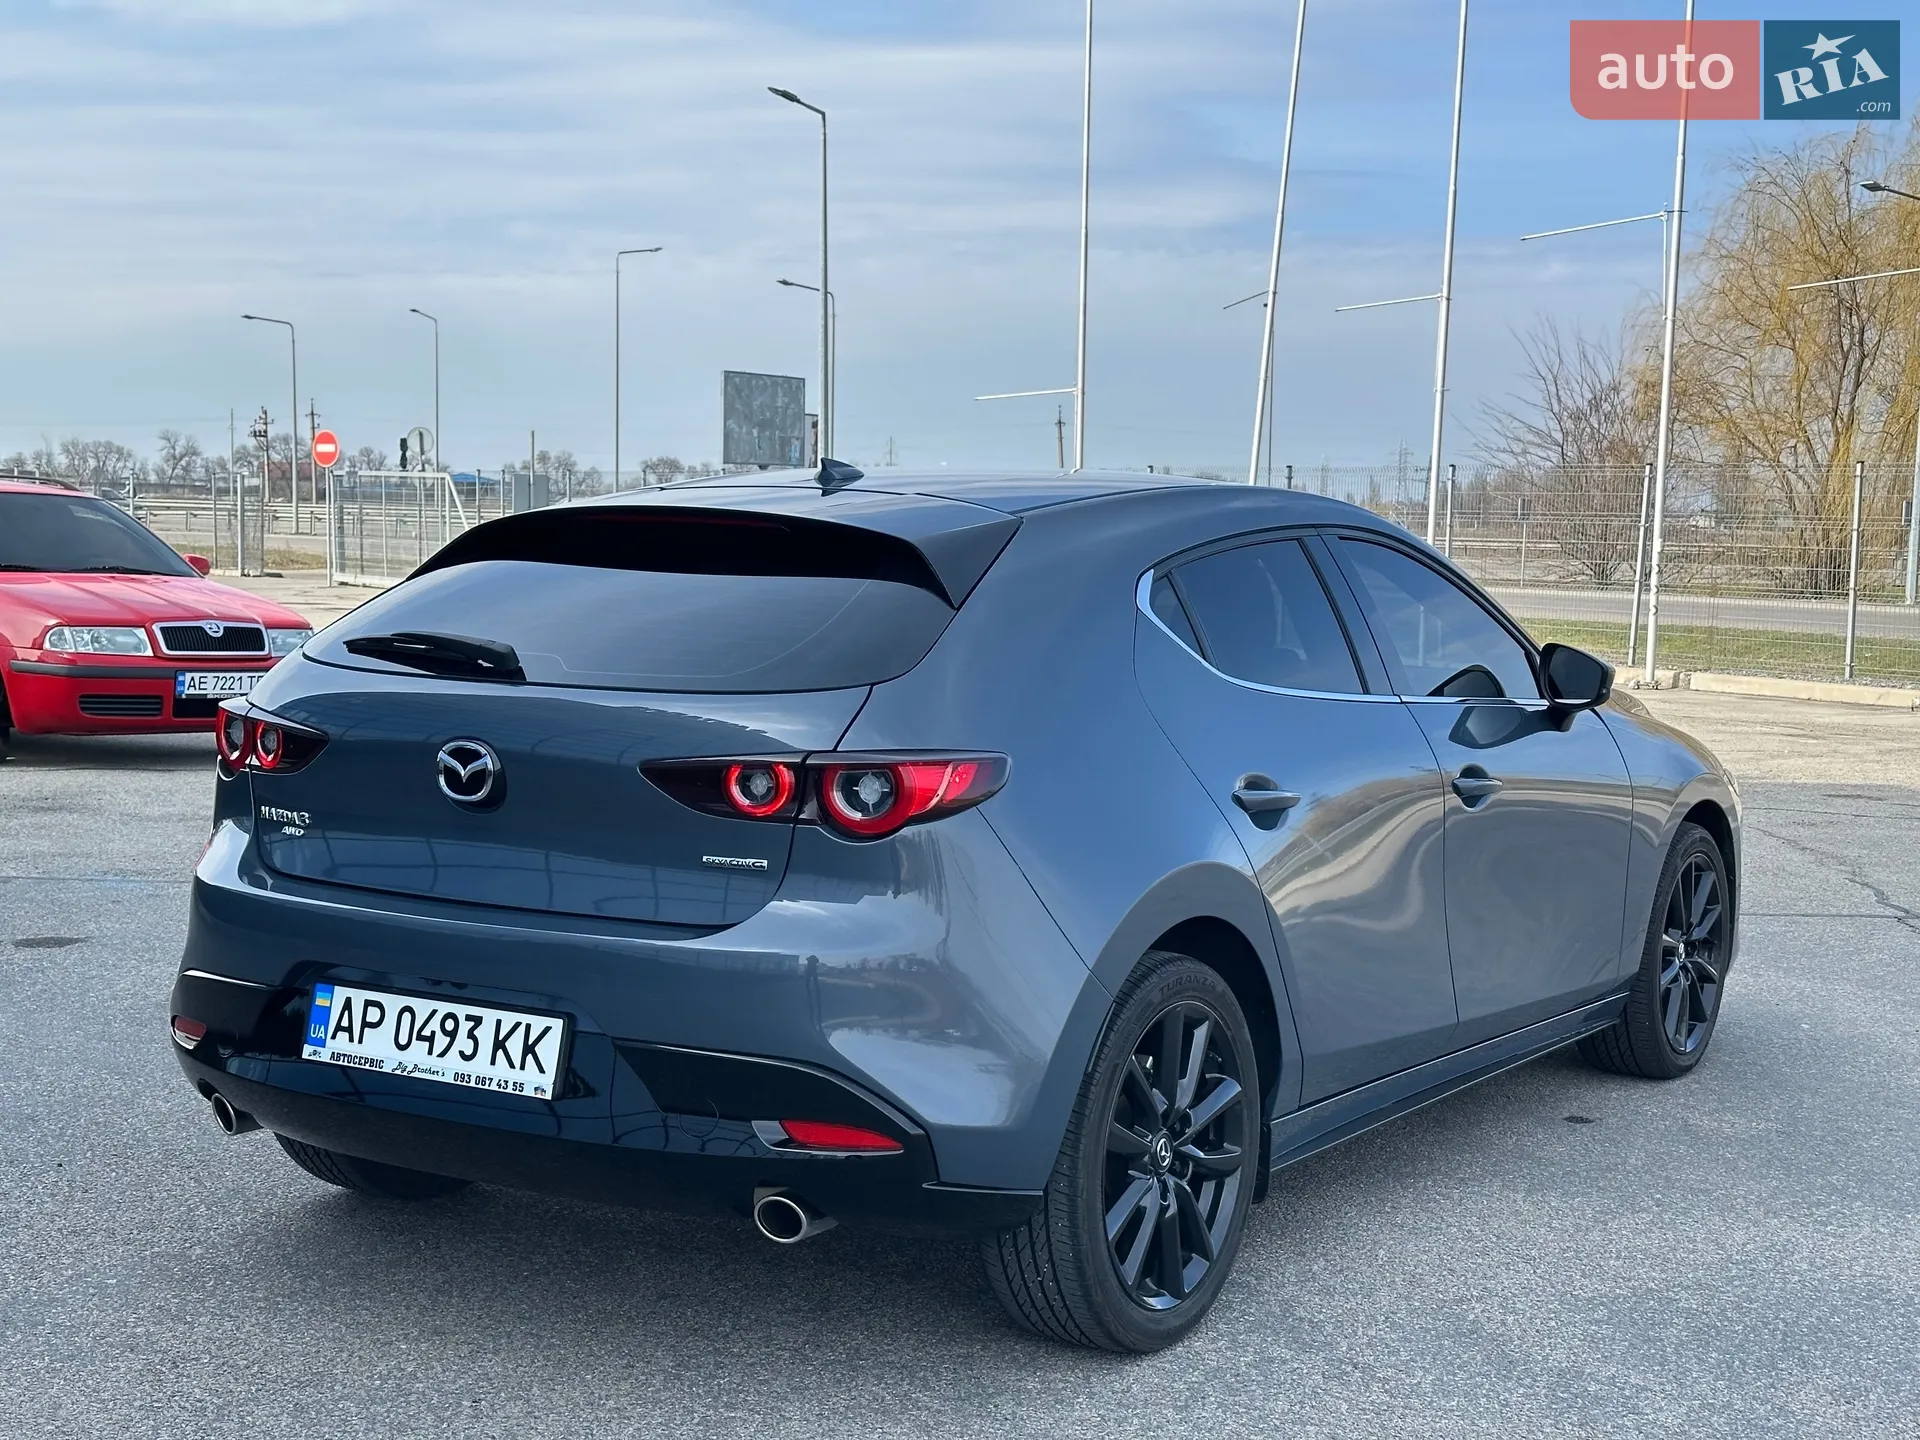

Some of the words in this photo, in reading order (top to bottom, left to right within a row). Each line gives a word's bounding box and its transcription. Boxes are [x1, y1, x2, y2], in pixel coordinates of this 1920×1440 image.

[186, 675, 208, 691] AE
[212, 675, 243, 691] 7221
[260, 805, 310, 826] MAZDA3
[1159, 974, 1216, 997] TURANZA
[310, 1023, 326, 1040] UA
[330, 996, 386, 1045] AP
[393, 1005, 484, 1062] 0493
[489, 1018, 553, 1075] KK
[329, 1051, 385, 1070] АВТОСЕРВІС
[391, 1061, 408, 1074] Big
[453, 1071, 472, 1084] 093
[474, 1075, 494, 1088] 067
[496, 1078, 509, 1091] 43
[511, 1081, 525, 1093] 55
